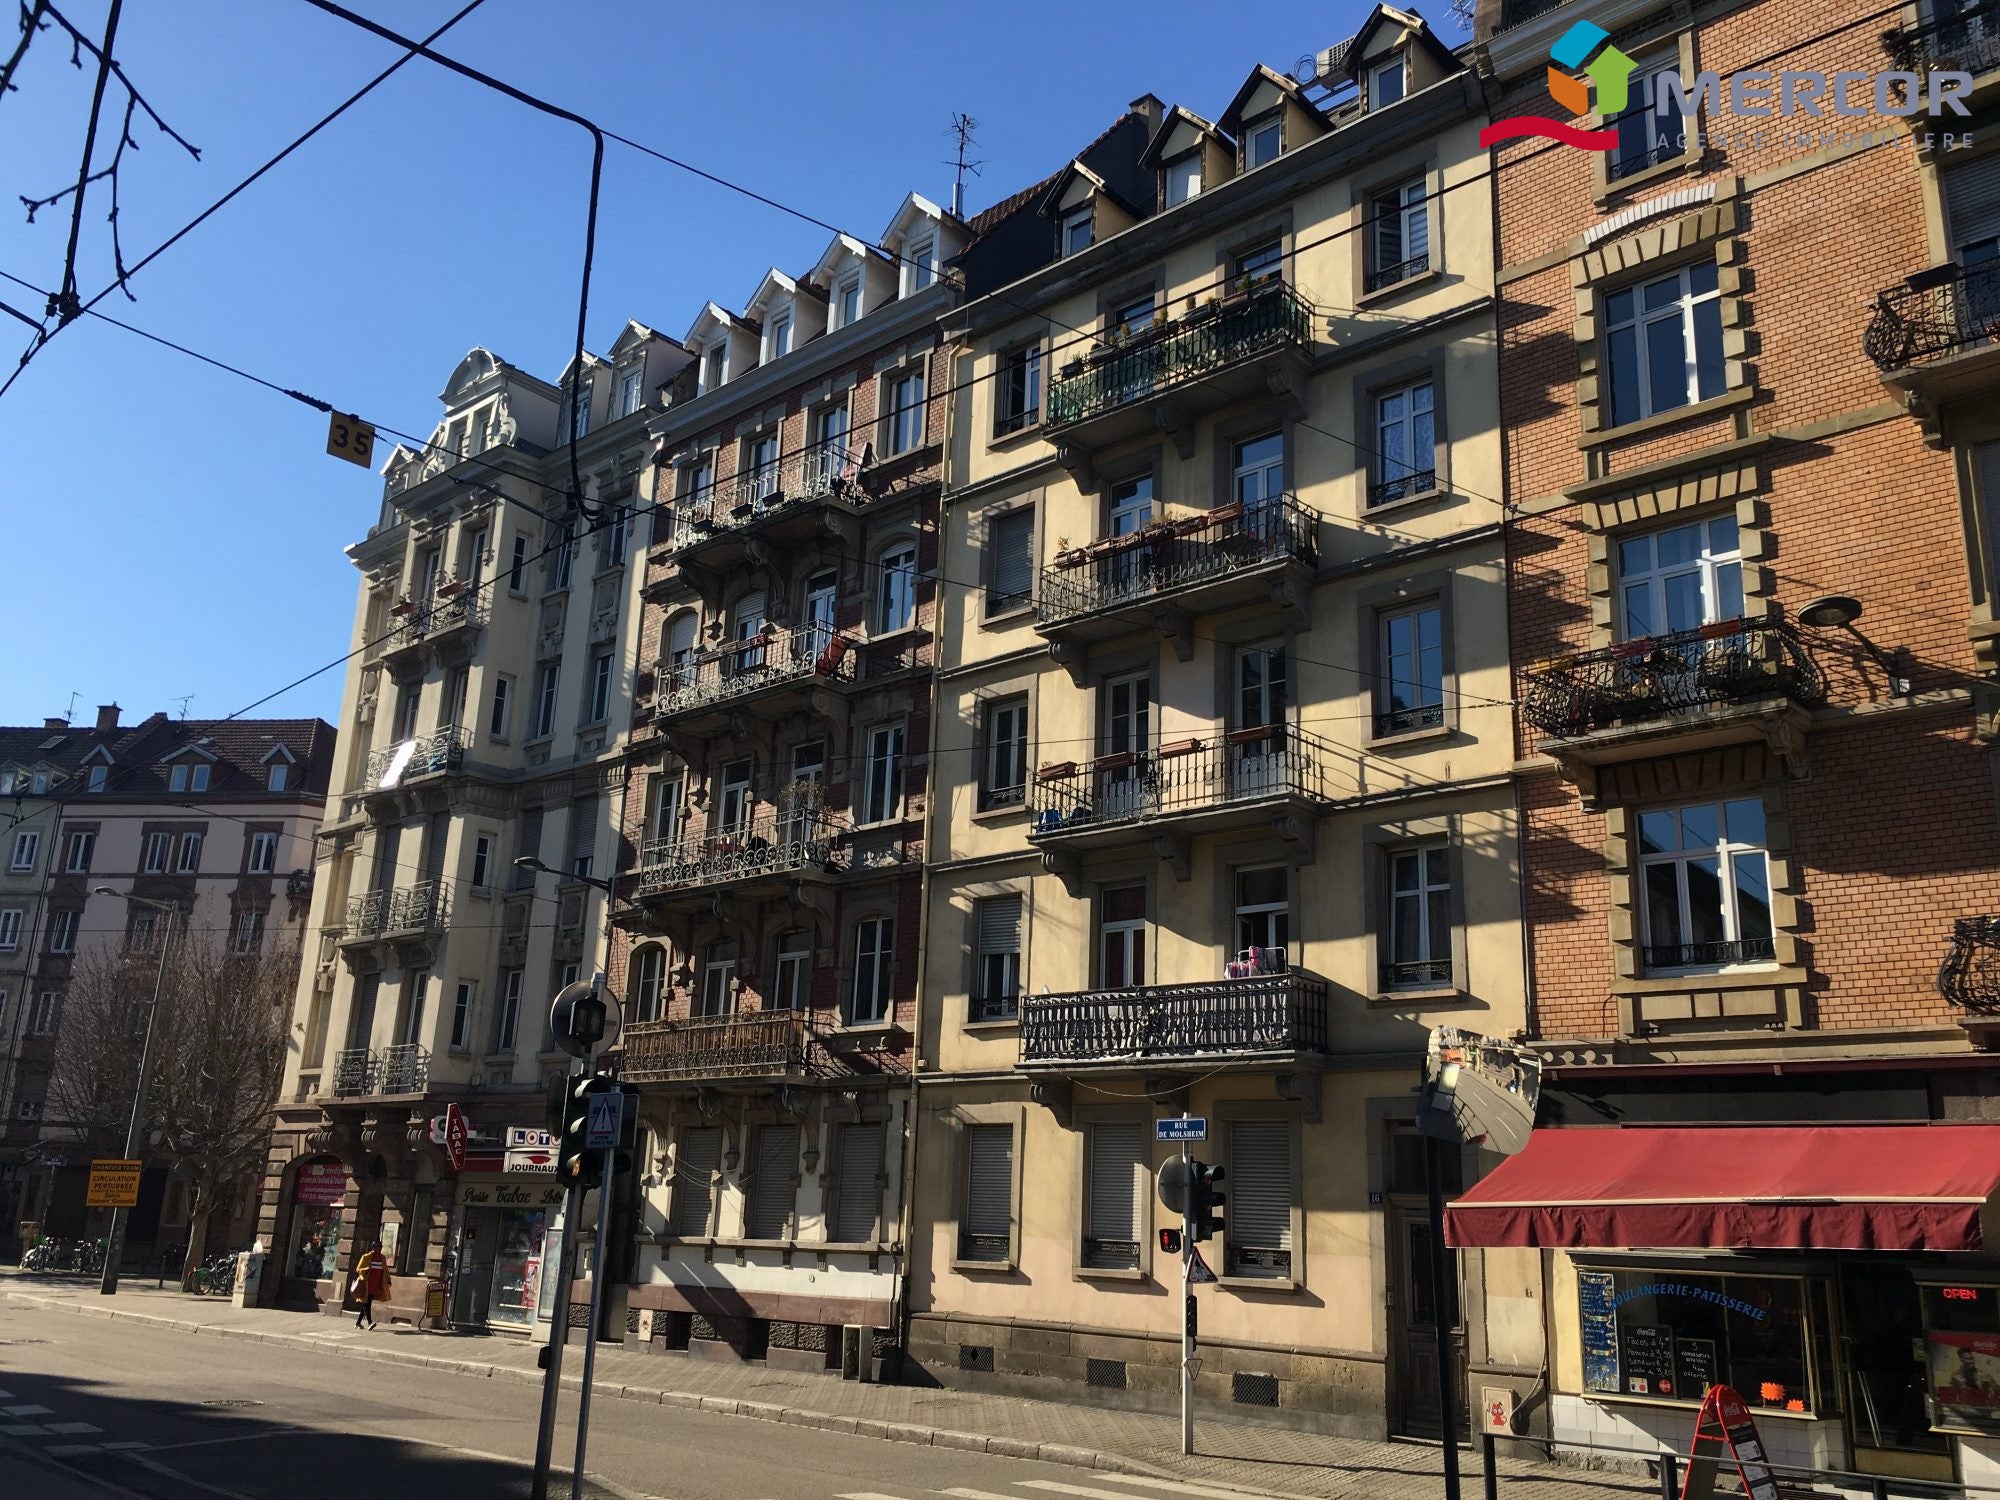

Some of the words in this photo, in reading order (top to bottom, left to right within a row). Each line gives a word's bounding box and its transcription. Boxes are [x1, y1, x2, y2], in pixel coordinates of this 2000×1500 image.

[332, 424, 369, 456] 35
[452, 1118, 463, 1155] TABAC
[1169, 1130, 1204, 1138] MOLSHEIM
[496, 1185, 531, 1204] Tabac
[1371, 1193, 1380, 1203] 16
[1942, 1288, 1978, 1299] OPEN
